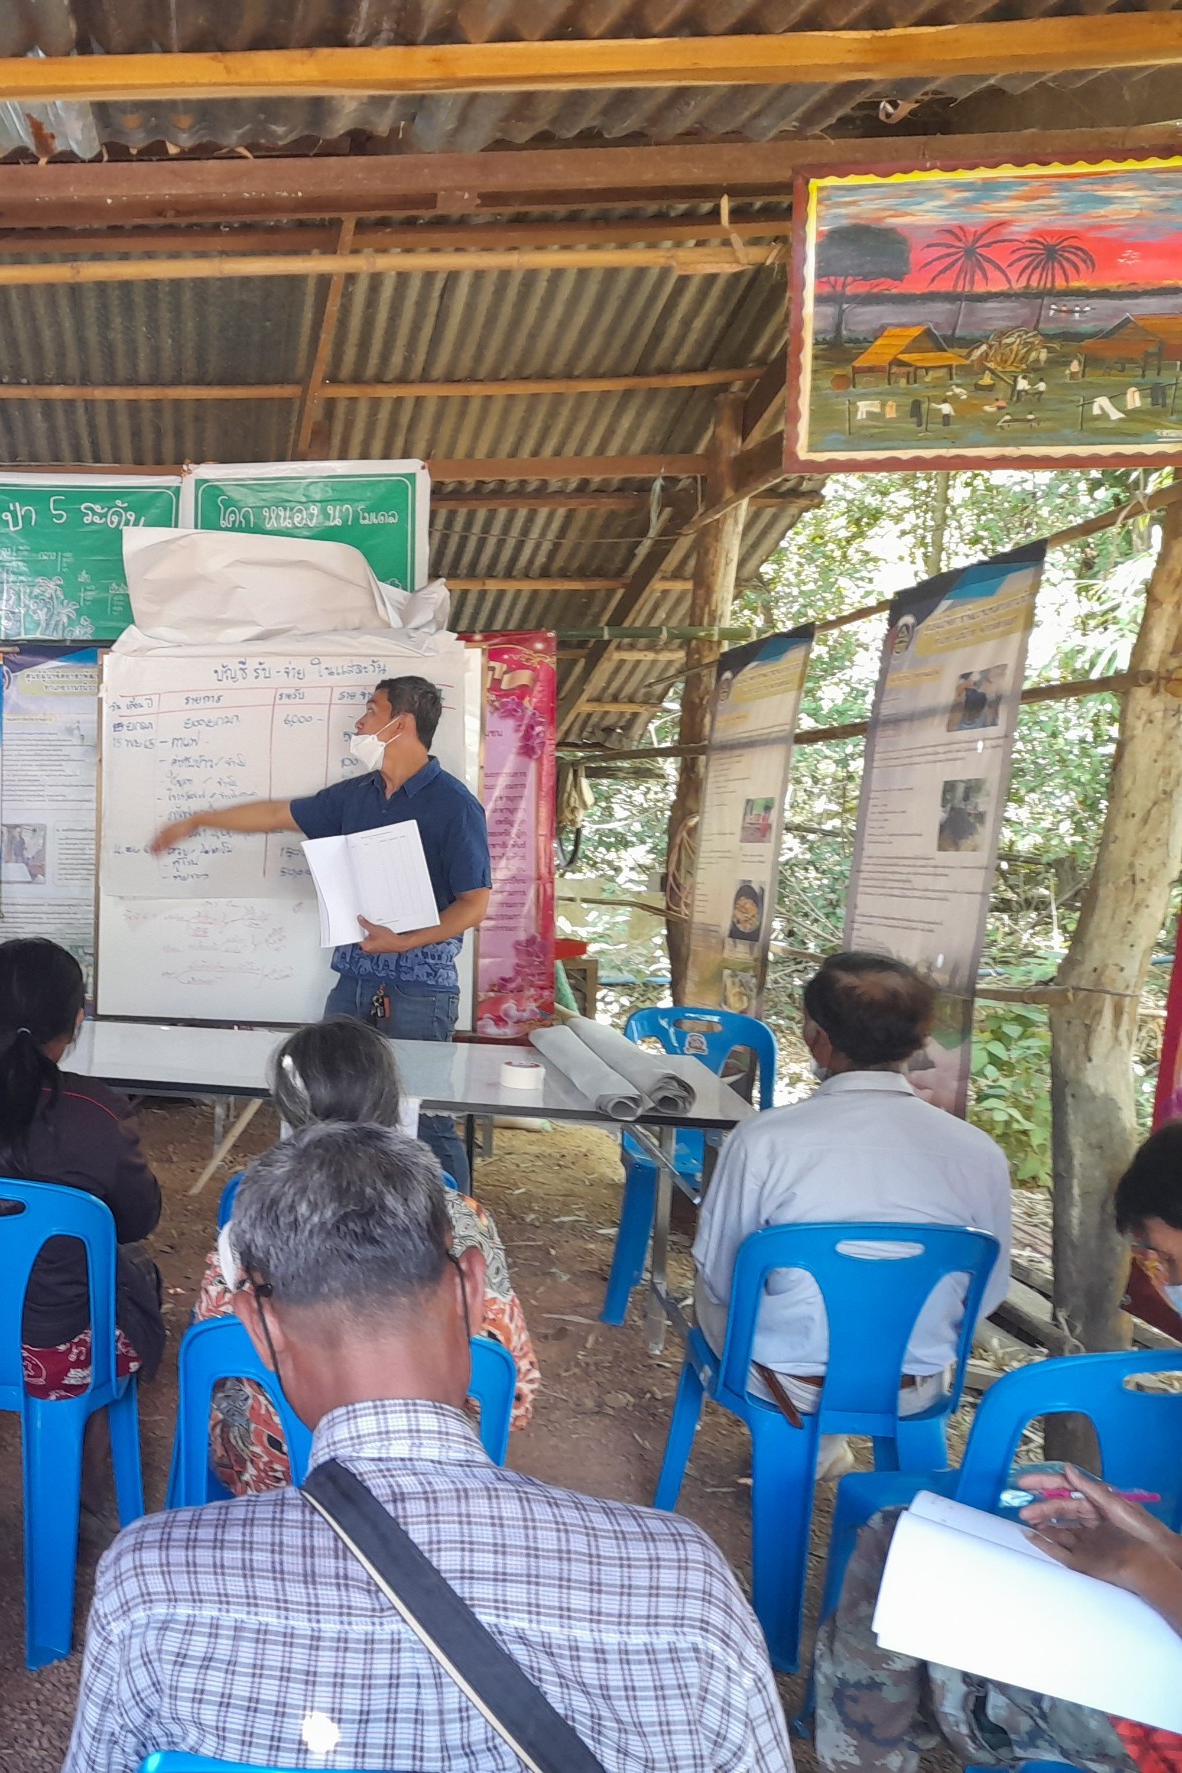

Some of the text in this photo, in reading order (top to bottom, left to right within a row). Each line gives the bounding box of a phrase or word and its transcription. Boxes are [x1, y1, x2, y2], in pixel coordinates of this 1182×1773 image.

[1, 496, 146, 532] ป่า 5 ระดับ
[218, 496, 254, 528] โคก
[263, 504, 319, 528] หนอง
[326, 504, 353, 527] นา
